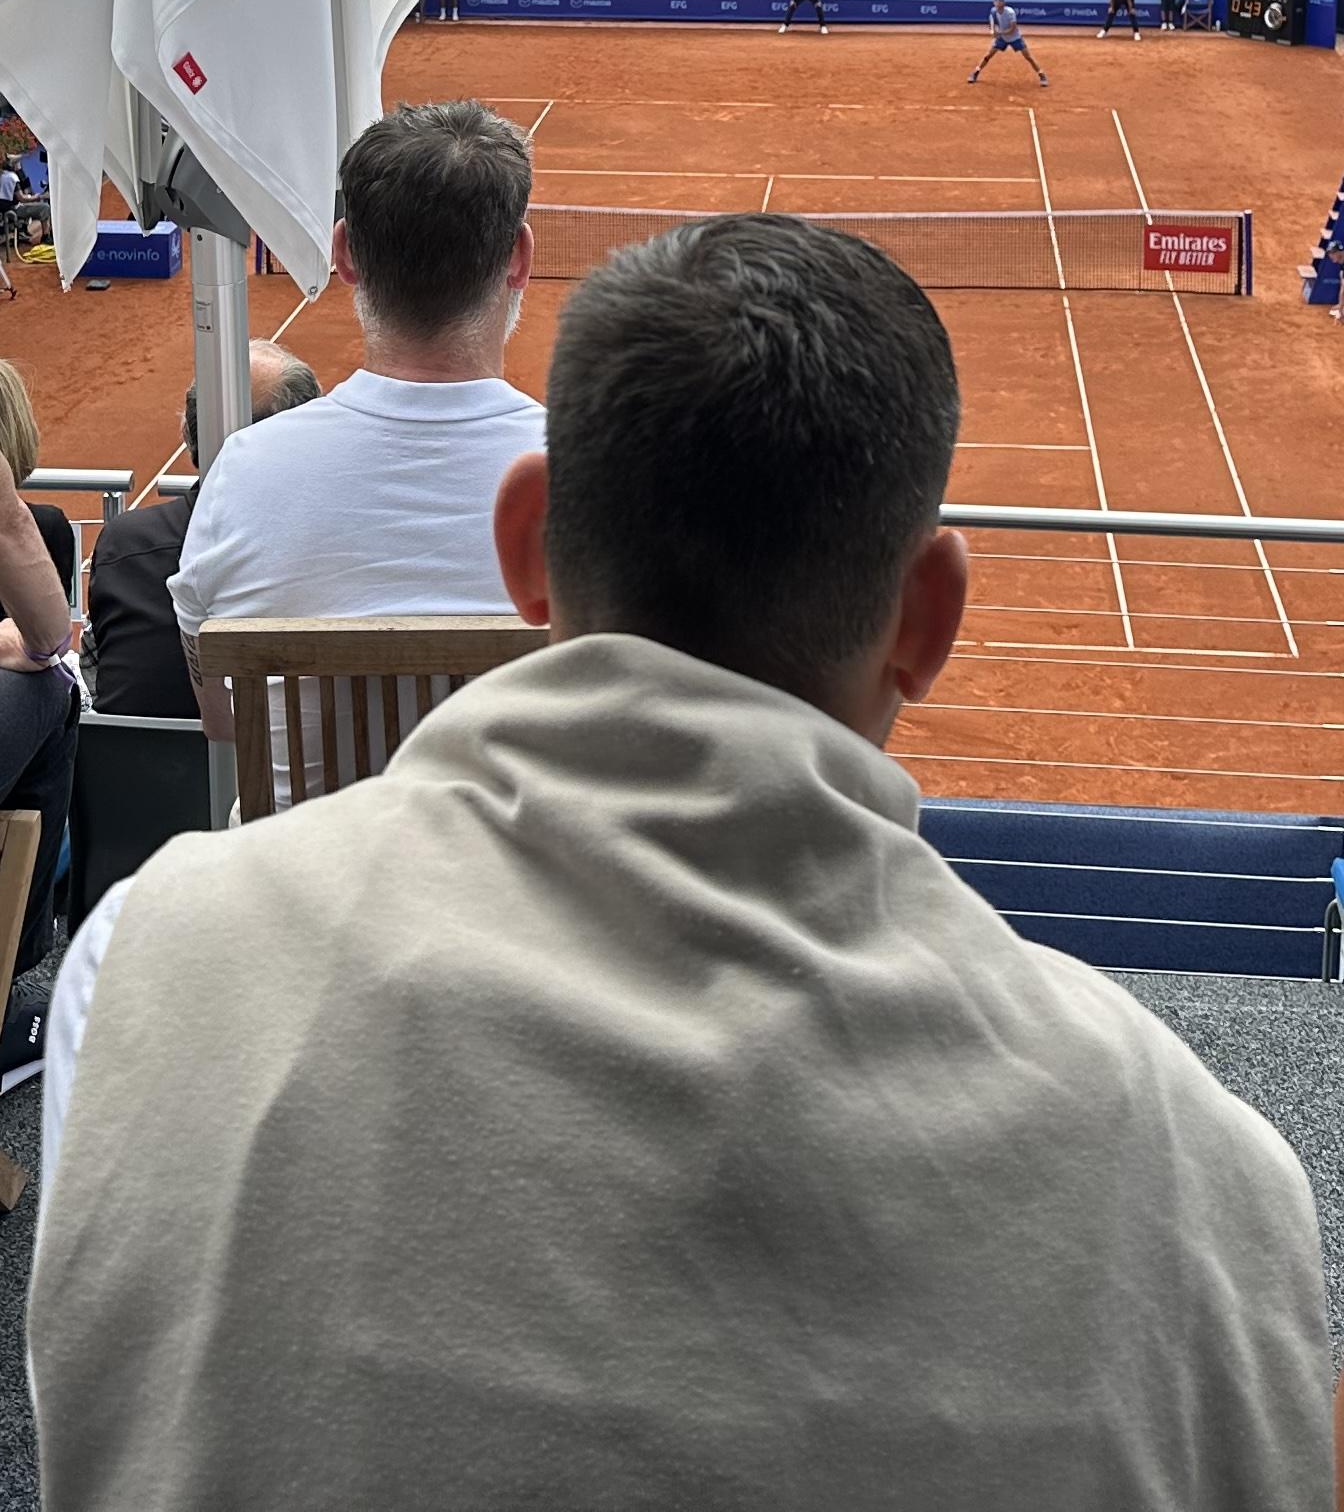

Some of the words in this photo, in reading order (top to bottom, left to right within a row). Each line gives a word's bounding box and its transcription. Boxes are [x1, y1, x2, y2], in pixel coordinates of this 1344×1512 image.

[670, 0, 687, 9] EFG
[721, 1, 738, 10] EFG
[771, 2, 789, 11] EFG
[823, 3, 839, 12] EFG
[871, 4, 889, 13] EFG
[920, 5, 938, 15] EFG
[1149, 231, 1228, 252] Emirates
[1159, 249, 1177, 265] FLY
[1178, 250, 1216, 266] BETTER
[28, 1015, 41, 1043] BOSS
